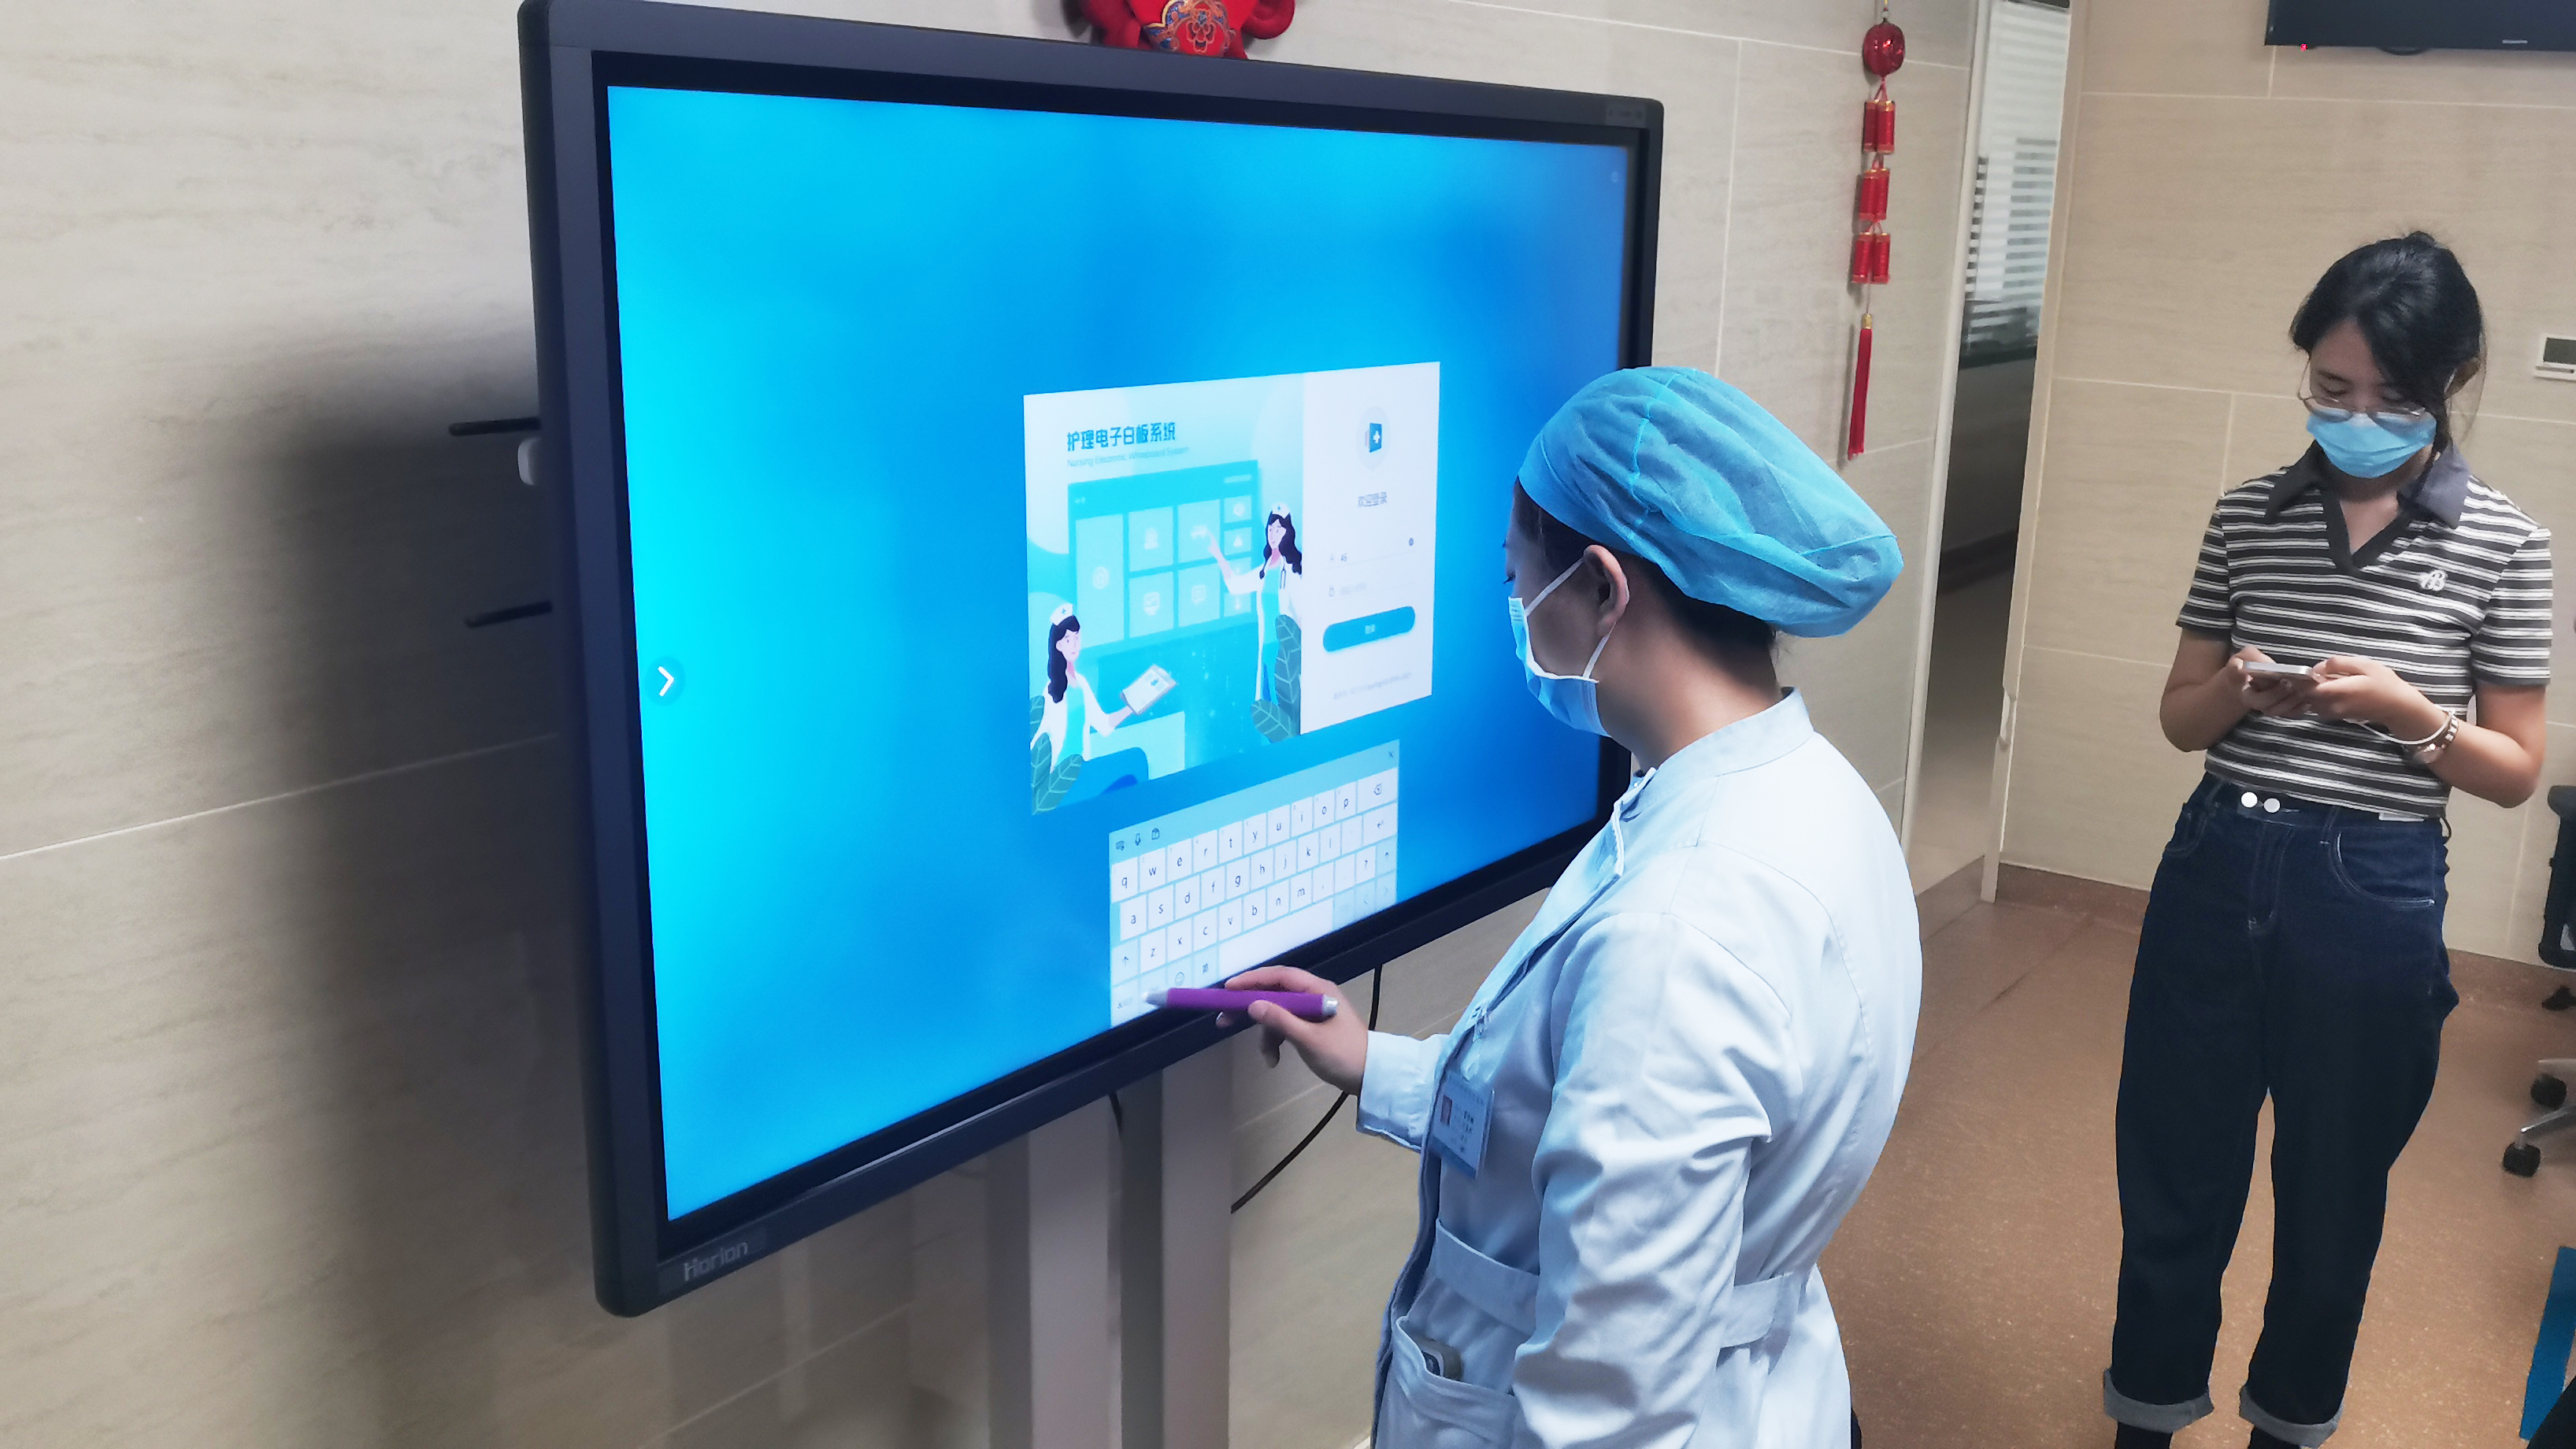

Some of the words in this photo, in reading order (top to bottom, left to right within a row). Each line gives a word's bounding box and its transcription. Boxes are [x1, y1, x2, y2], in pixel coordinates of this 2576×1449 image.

[1067, 421, 1176, 452] 护理电子白板系统
[1121, 876, 1128, 889] q
[1148, 867, 1157, 876] w
[1177, 857, 1183, 867] e
[1252, 831, 1258, 843] y
[1276, 822, 1282, 832] u
[1321, 806, 1327, 815] o
[1344, 798, 1349, 810] p
[1130, 914, 1136, 925] a
[1158, 904, 1164, 914] s
[1184, 891, 1191, 904] d
[1234, 875, 1241, 888] g
[1306, 847, 1311, 857] k
[1150, 947, 1156, 958] z
[1177, 937, 1182, 946] x
[1203, 926, 1208, 936] c
[1251, 905, 1258, 916] b
[1276, 898, 1281, 906] n
[1297, 888, 1305, 898] m
